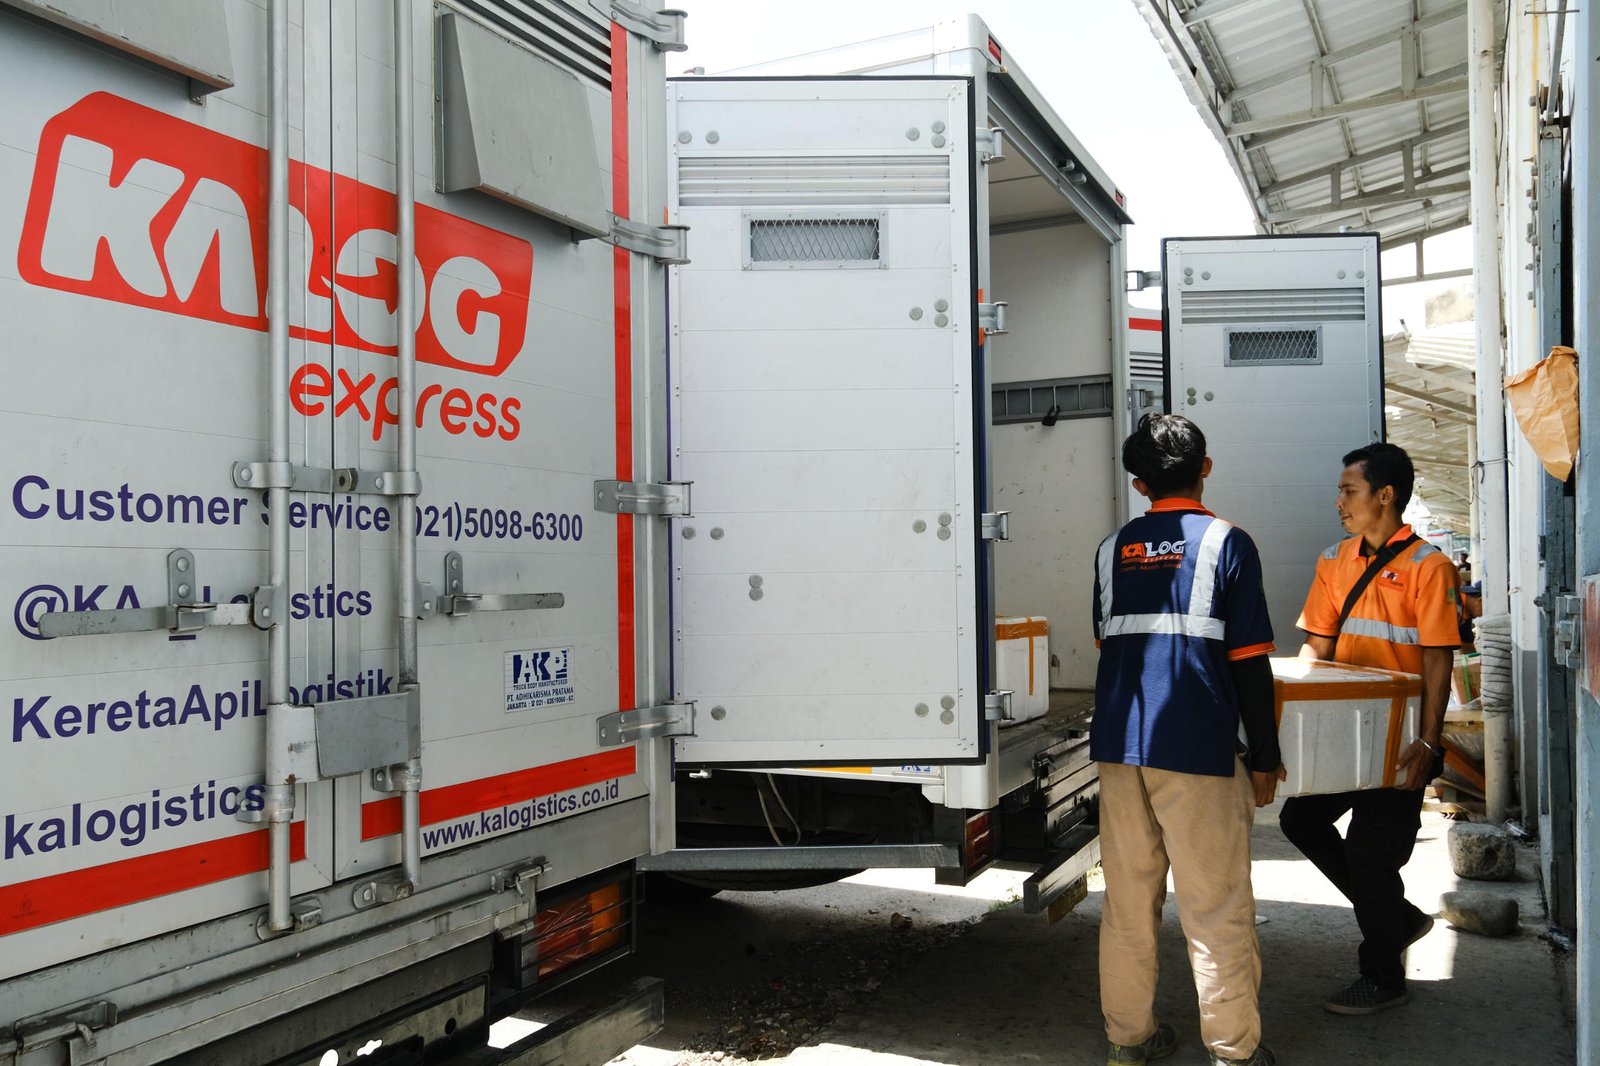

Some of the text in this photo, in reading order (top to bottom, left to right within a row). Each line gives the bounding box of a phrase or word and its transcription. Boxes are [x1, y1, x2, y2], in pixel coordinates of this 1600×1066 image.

[289, 363, 521, 441] express
[12, 475, 248, 525] Customer
[1121, 540, 1186, 559] KALOG
[527, 682, 538, 690] BODY
[552, 687, 574, 697] PRATAMA
[506, 702, 527, 711] JAKARTA
[4, 780, 266, 860] kalogistics
[423, 778, 619, 850] www.kalogistics.co.id
